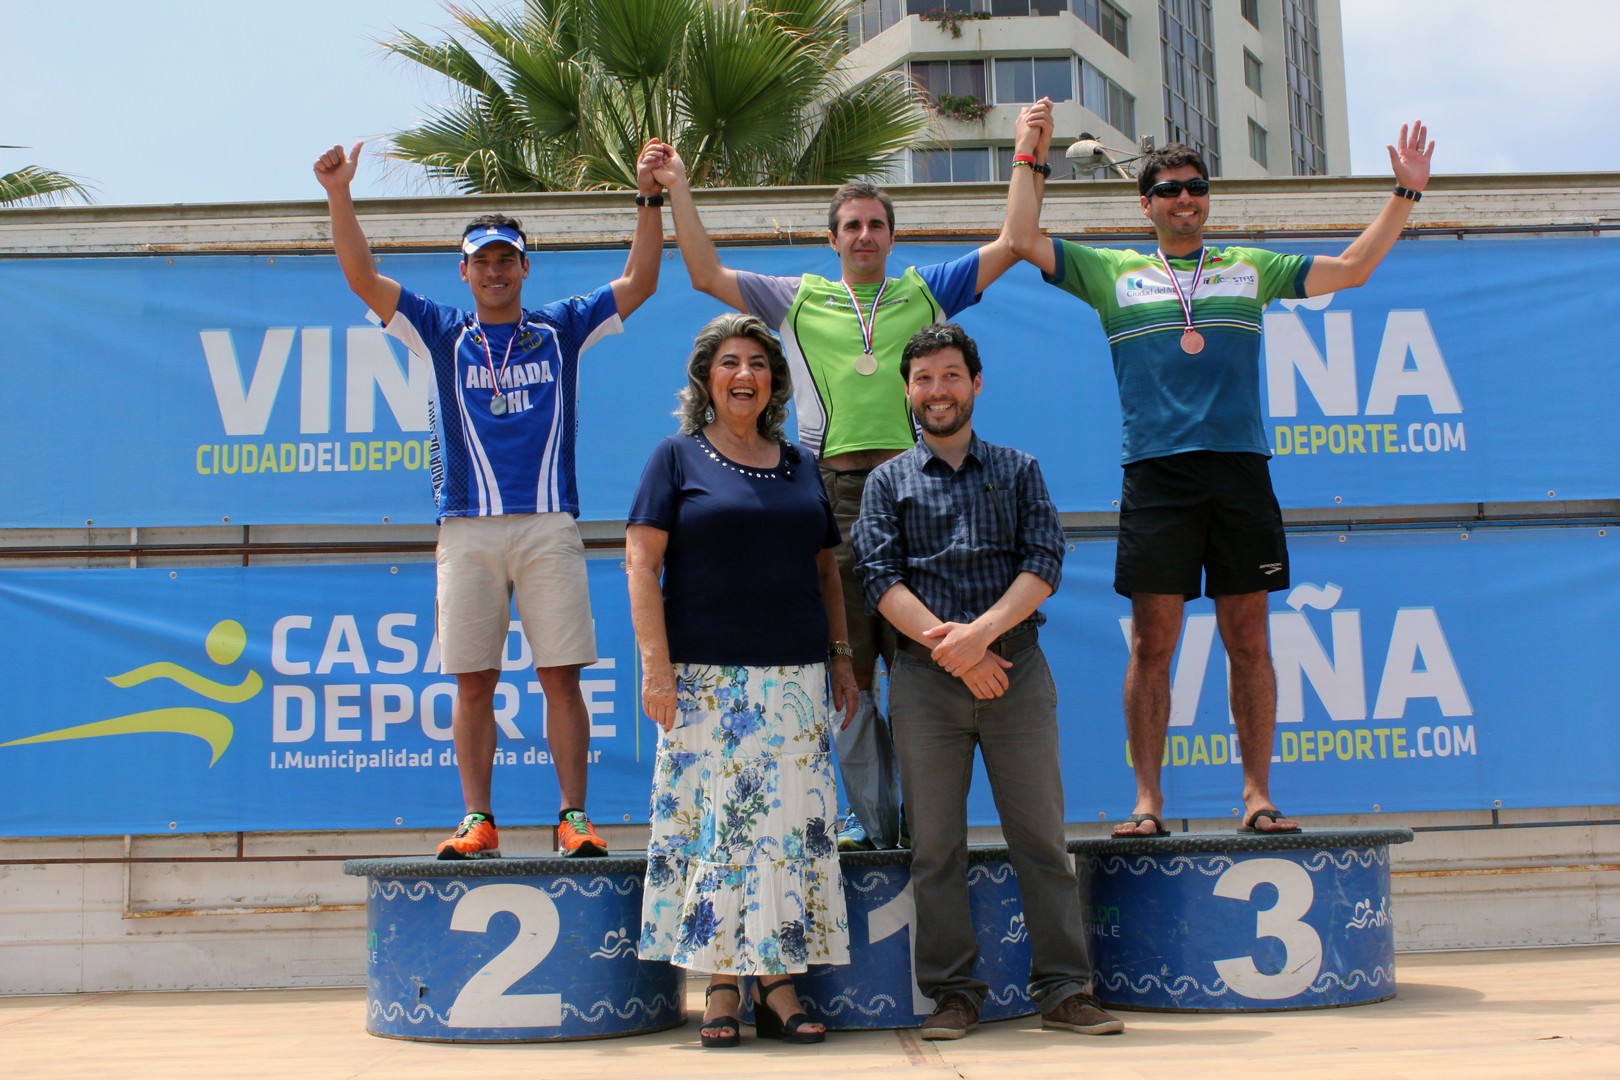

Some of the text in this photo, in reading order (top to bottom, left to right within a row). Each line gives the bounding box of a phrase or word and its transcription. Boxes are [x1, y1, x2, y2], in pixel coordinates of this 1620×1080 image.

[200, 310, 431, 436] VIÑ
[466, 360, 554, 389] ARMADA
[1263, 293, 1464, 418] ÑA
[491, 390, 533, 414] HL
[196, 439, 431, 475] CIUDADDELDEPO
[1271, 422, 1466, 456] DEPORTE.COM
[1119, 582, 1473, 727] VÑA
[270, 745, 432, 772] I.Municipalidad
[1126, 725, 1477, 769] DADDEPORTE.COM
[1086, 923, 1121, 937] HILE
[1213, 857, 1323, 1000] 3
[448, 883, 562, 1028] 2
